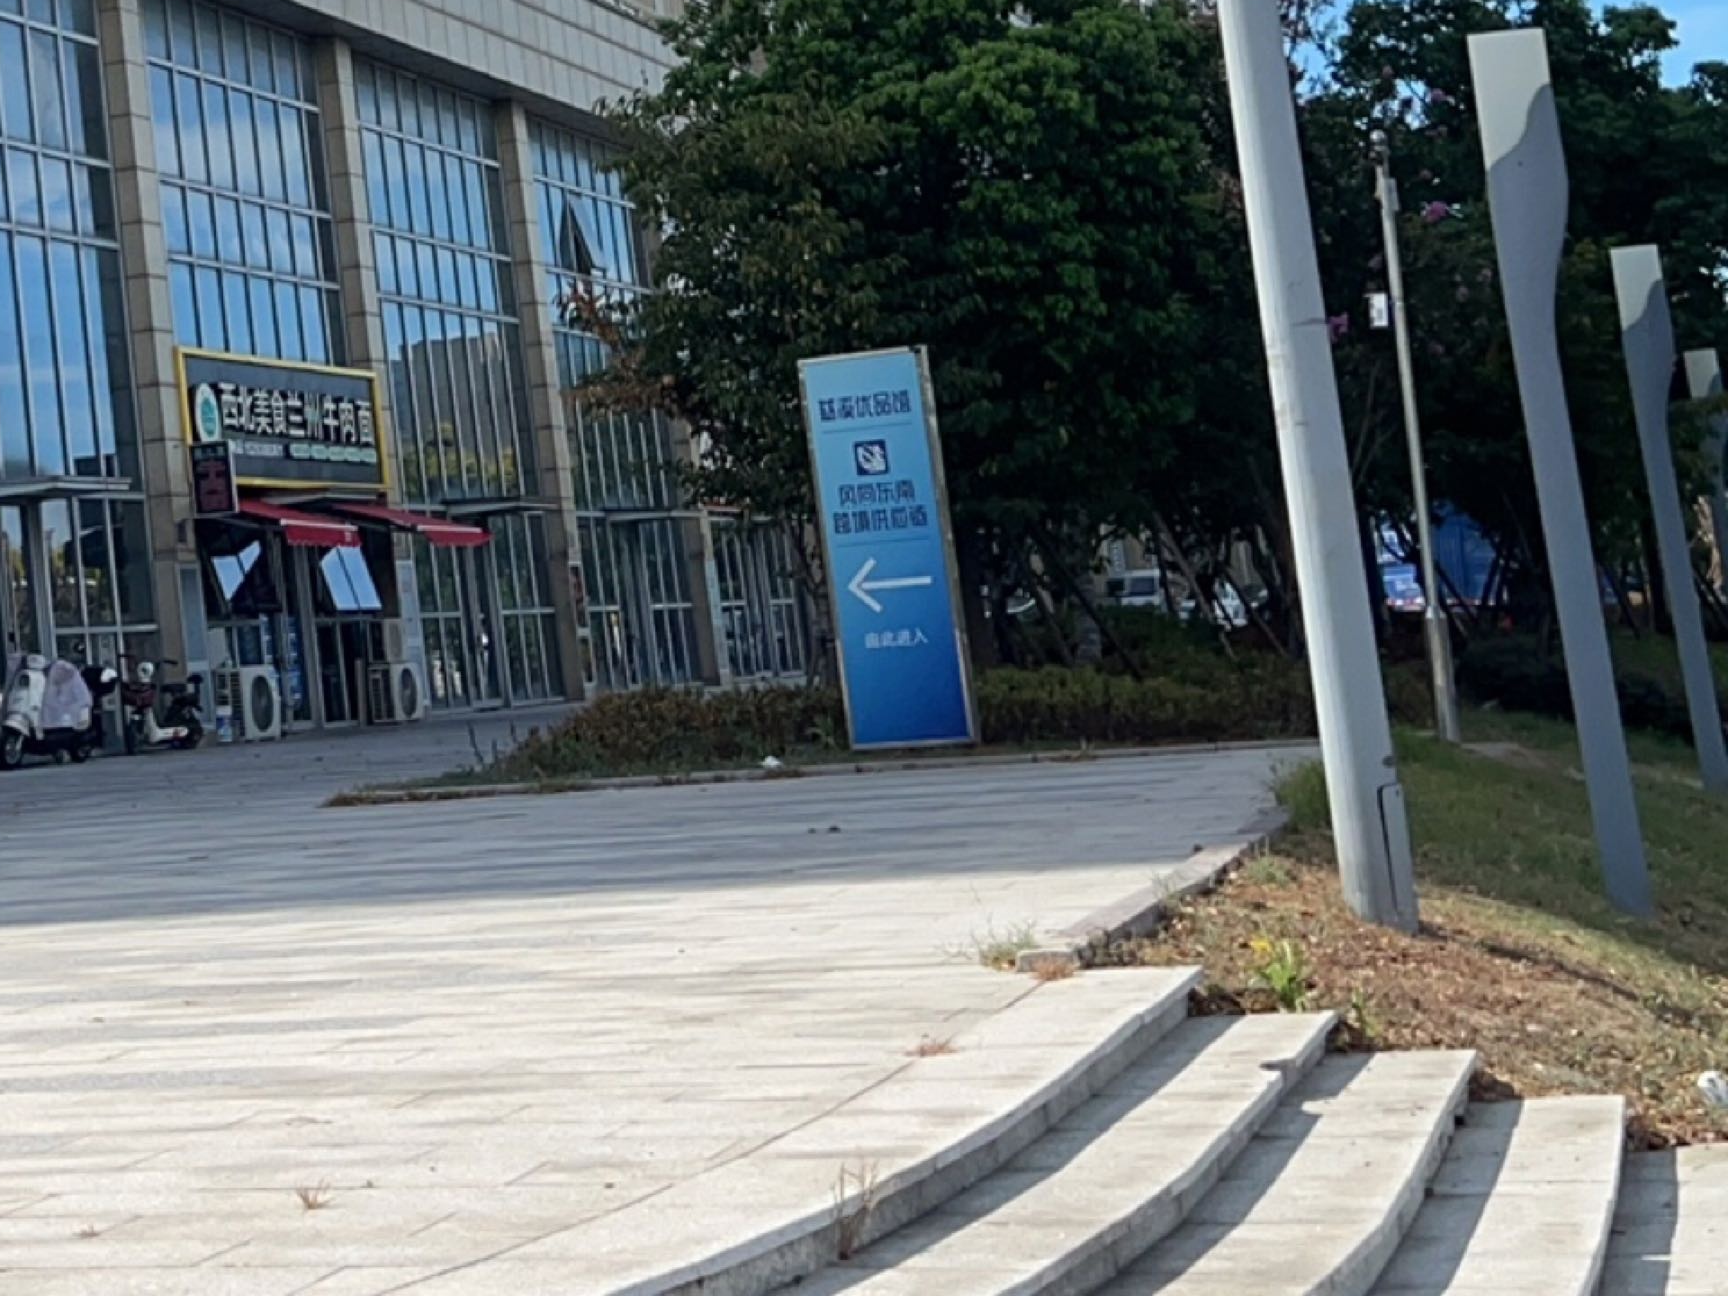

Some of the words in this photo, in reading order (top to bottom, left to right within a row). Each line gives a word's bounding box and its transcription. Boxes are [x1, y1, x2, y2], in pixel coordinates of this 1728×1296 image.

[218, 381, 373, 444] 西北美食兰州牛肉面
[818, 390, 912, 423] 慈溪优品馆
[838, 480, 915, 505] 风向东南
[832, 506, 928, 534] 跨境供应链
